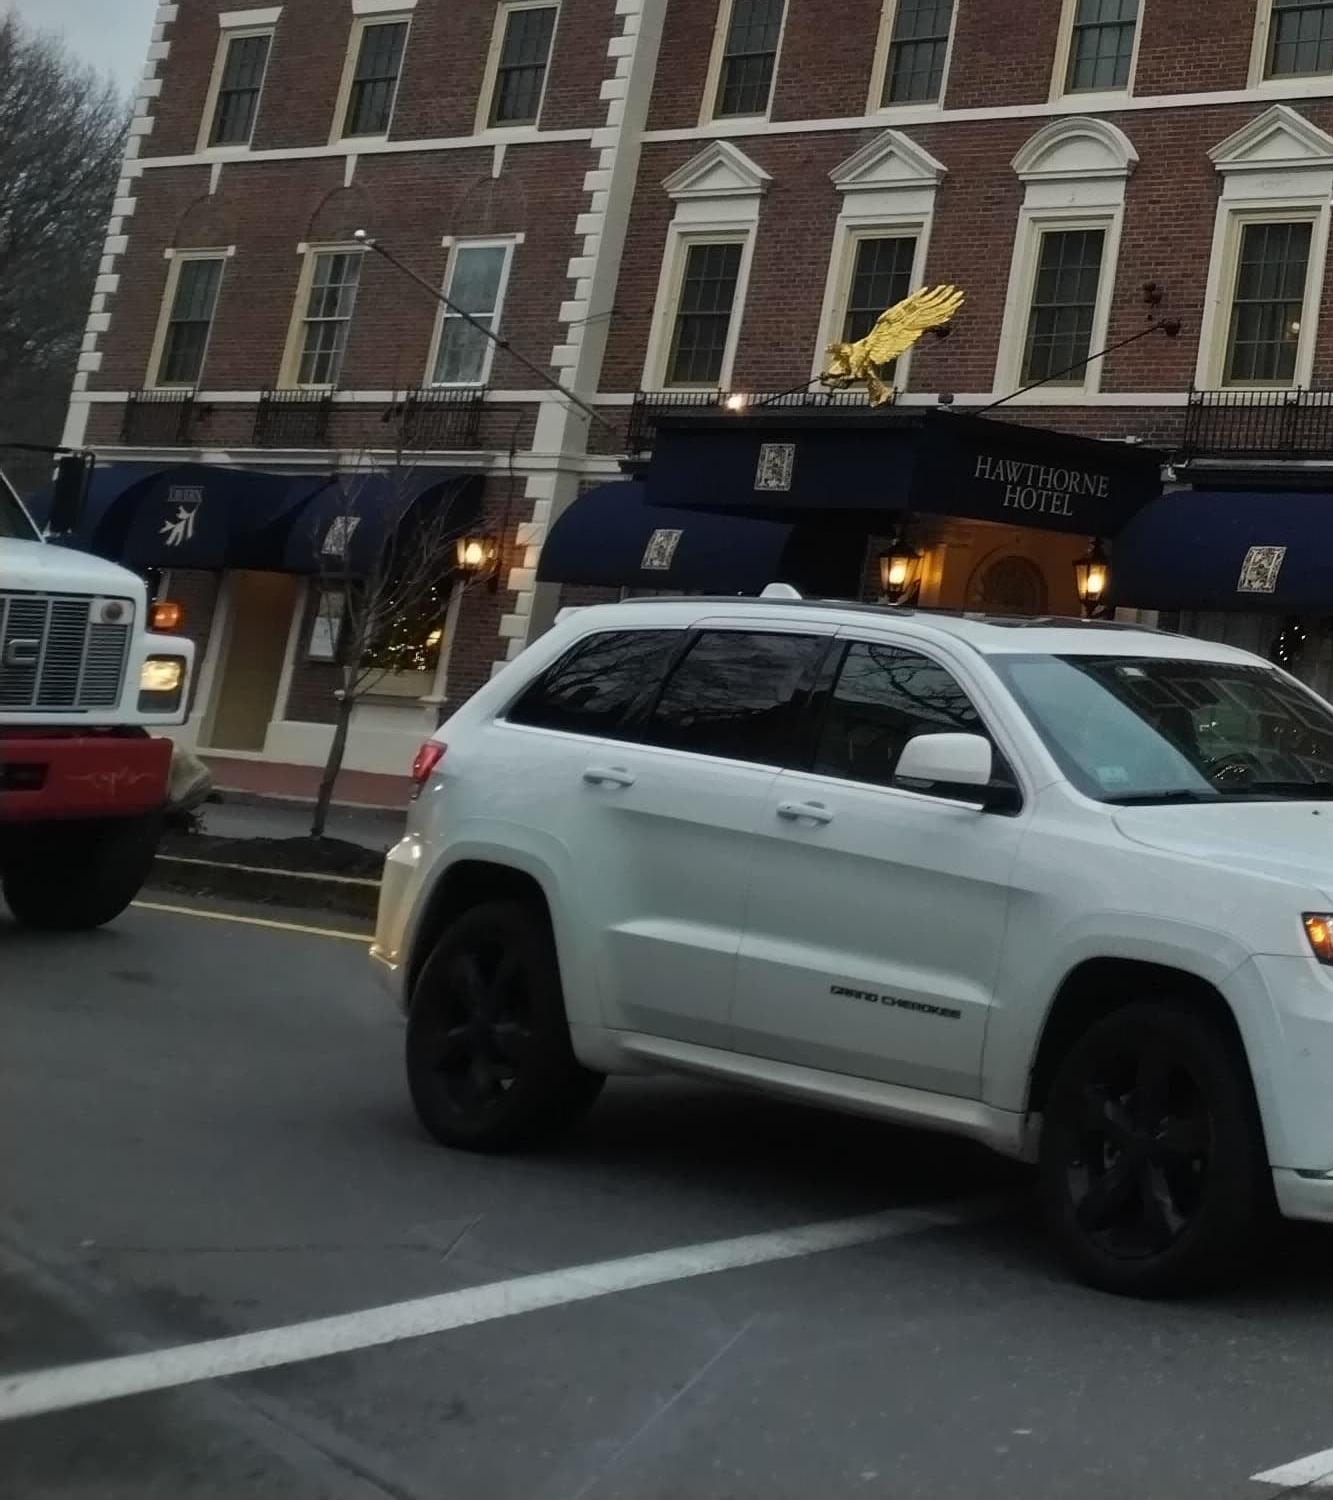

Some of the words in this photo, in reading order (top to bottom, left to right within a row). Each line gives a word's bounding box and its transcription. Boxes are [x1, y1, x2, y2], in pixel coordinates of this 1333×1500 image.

[974, 455, 1110, 498] HAWTHORNE
[1003, 484, 1073, 516] HOTEL
[830, 985, 878, 1002] GRAND
[881, 995, 961, 1019] CHEROKEE
